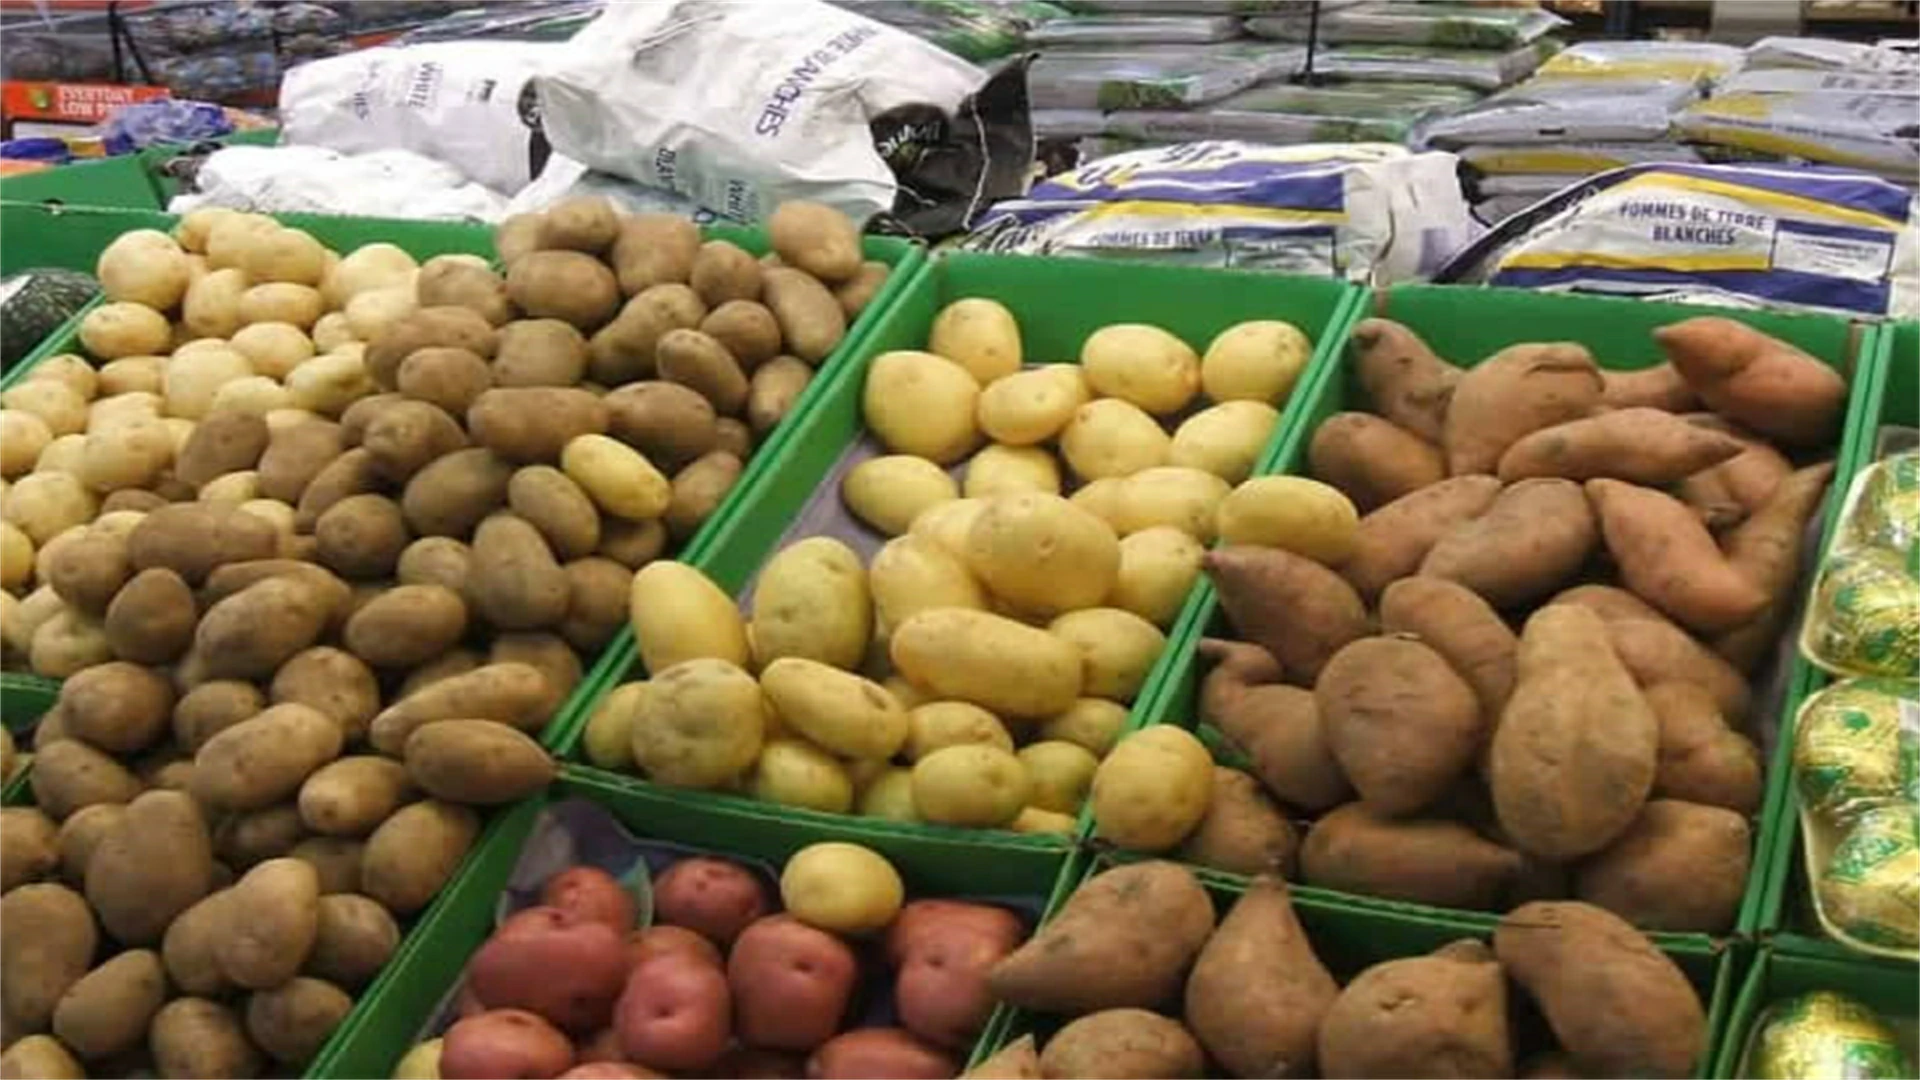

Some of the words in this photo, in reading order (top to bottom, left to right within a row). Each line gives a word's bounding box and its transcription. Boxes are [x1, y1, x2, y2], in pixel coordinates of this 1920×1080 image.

[58, 86, 135, 101] EVERYDAY
[58, 102, 95, 117] LOW
[1620, 201, 1686, 219] POMMES
[1692, 205, 1713, 222] DE
[1653, 226, 1736, 245] BLANCHES
